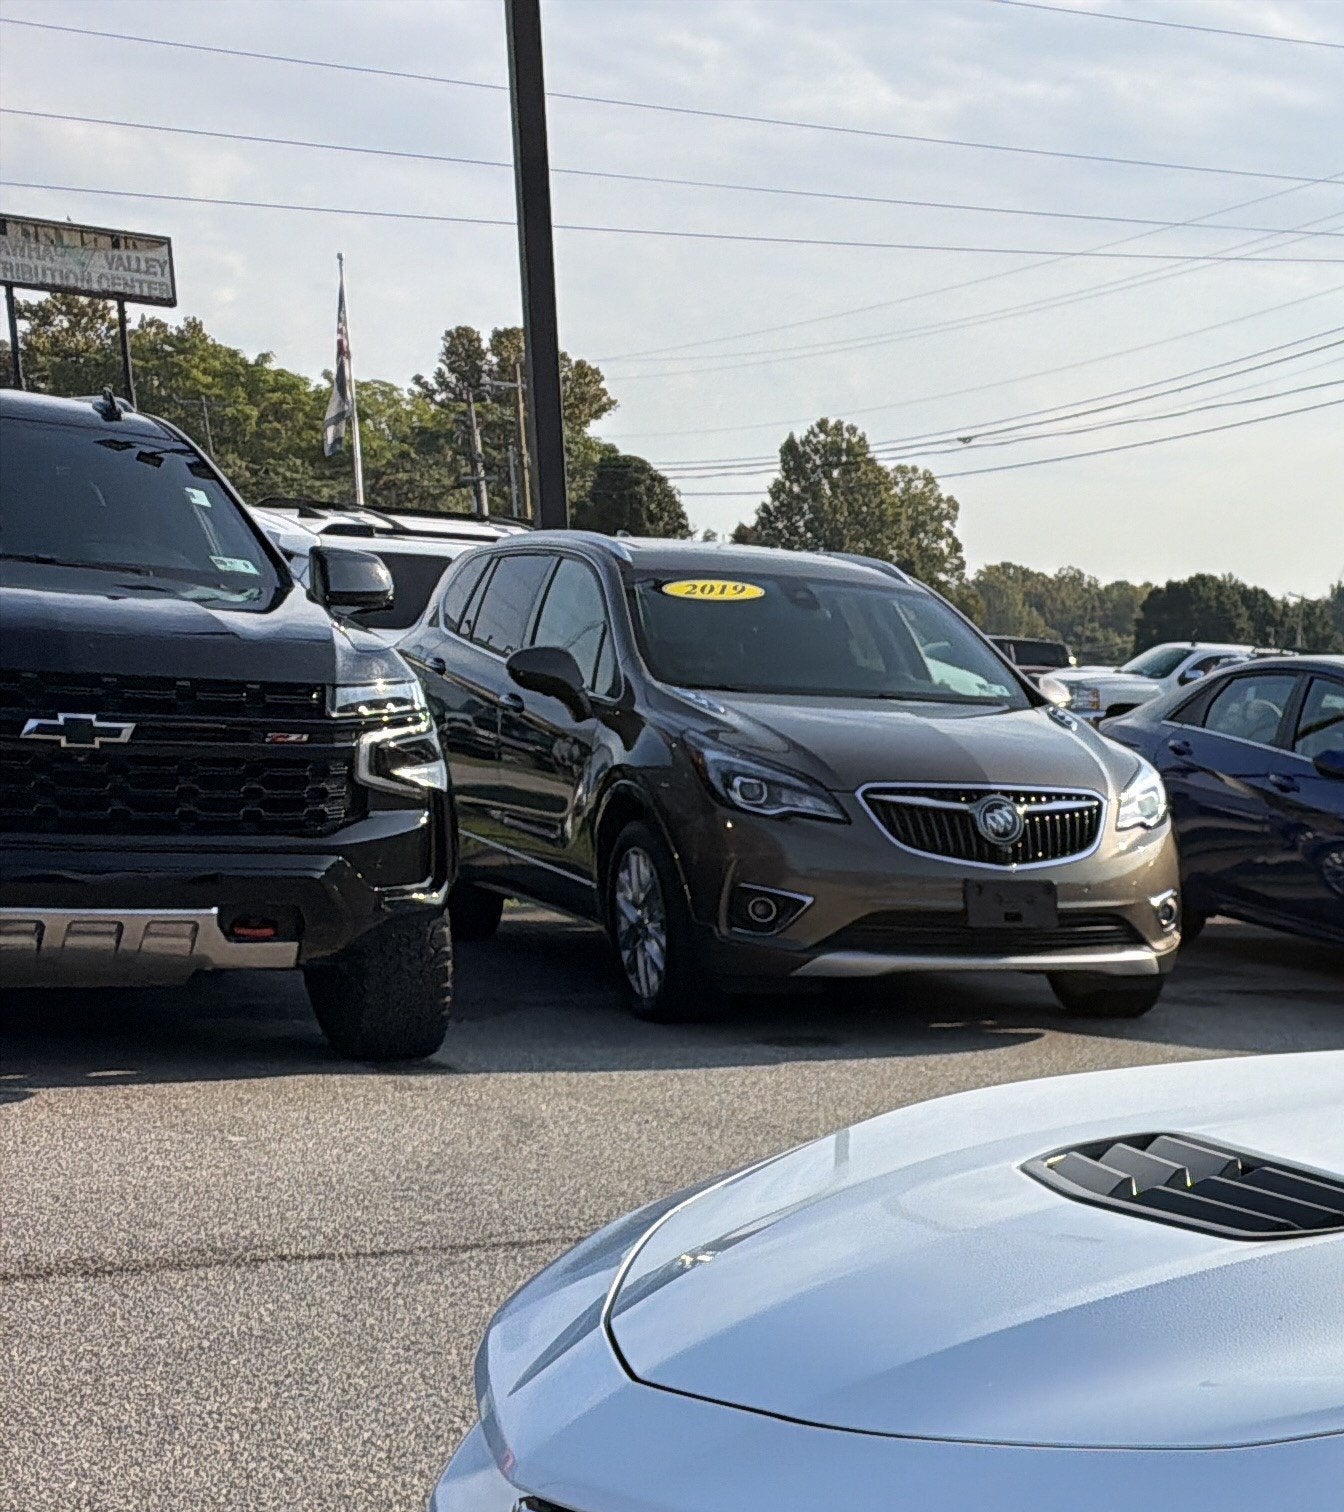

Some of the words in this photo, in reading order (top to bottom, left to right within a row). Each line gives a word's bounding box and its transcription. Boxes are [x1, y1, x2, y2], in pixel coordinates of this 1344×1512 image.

[103, 250, 168, 278] VALLEY
[98, 272, 168, 298] CENTER
[684, 583, 746, 596] 2019
